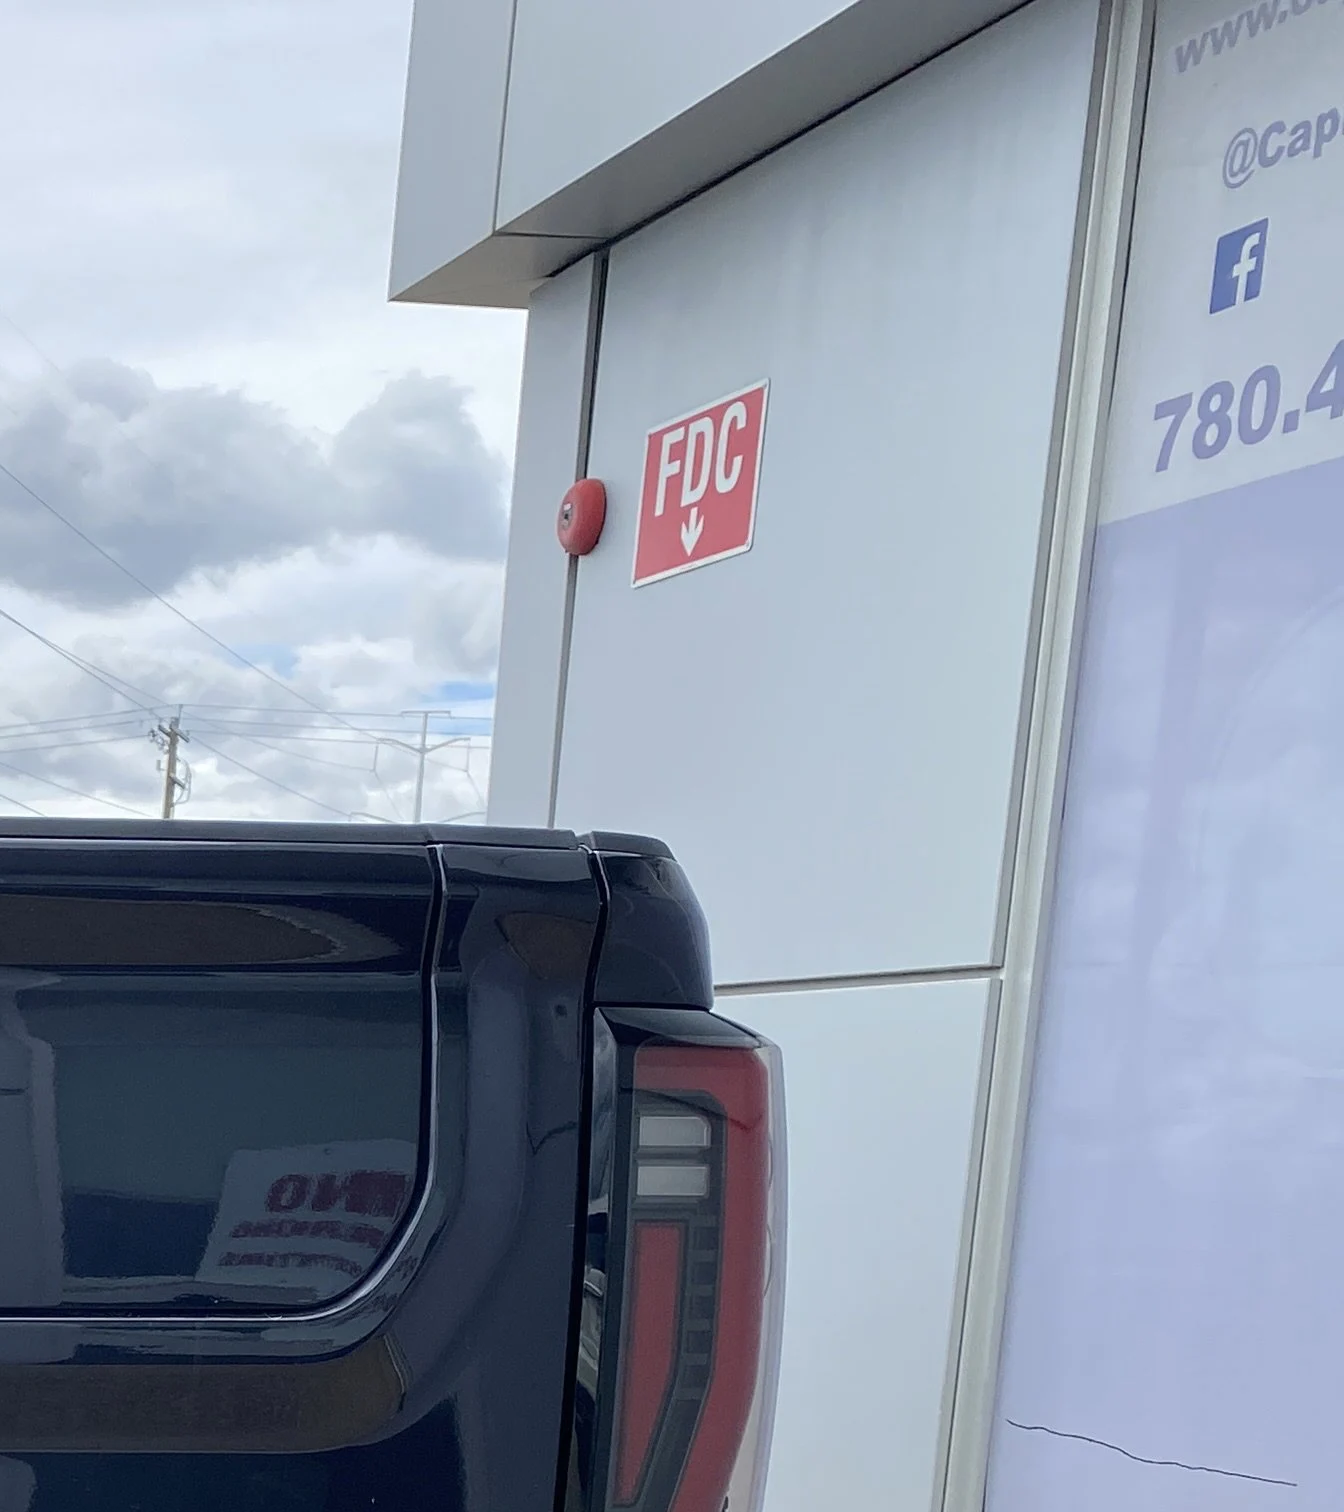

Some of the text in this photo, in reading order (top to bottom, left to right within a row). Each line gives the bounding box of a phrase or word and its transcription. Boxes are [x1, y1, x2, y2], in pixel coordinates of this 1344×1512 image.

[1222, 108, 1344, 189] @Cap
[655, 401, 746, 516] FDC
[1154, 339, 1344, 472] 780.4
